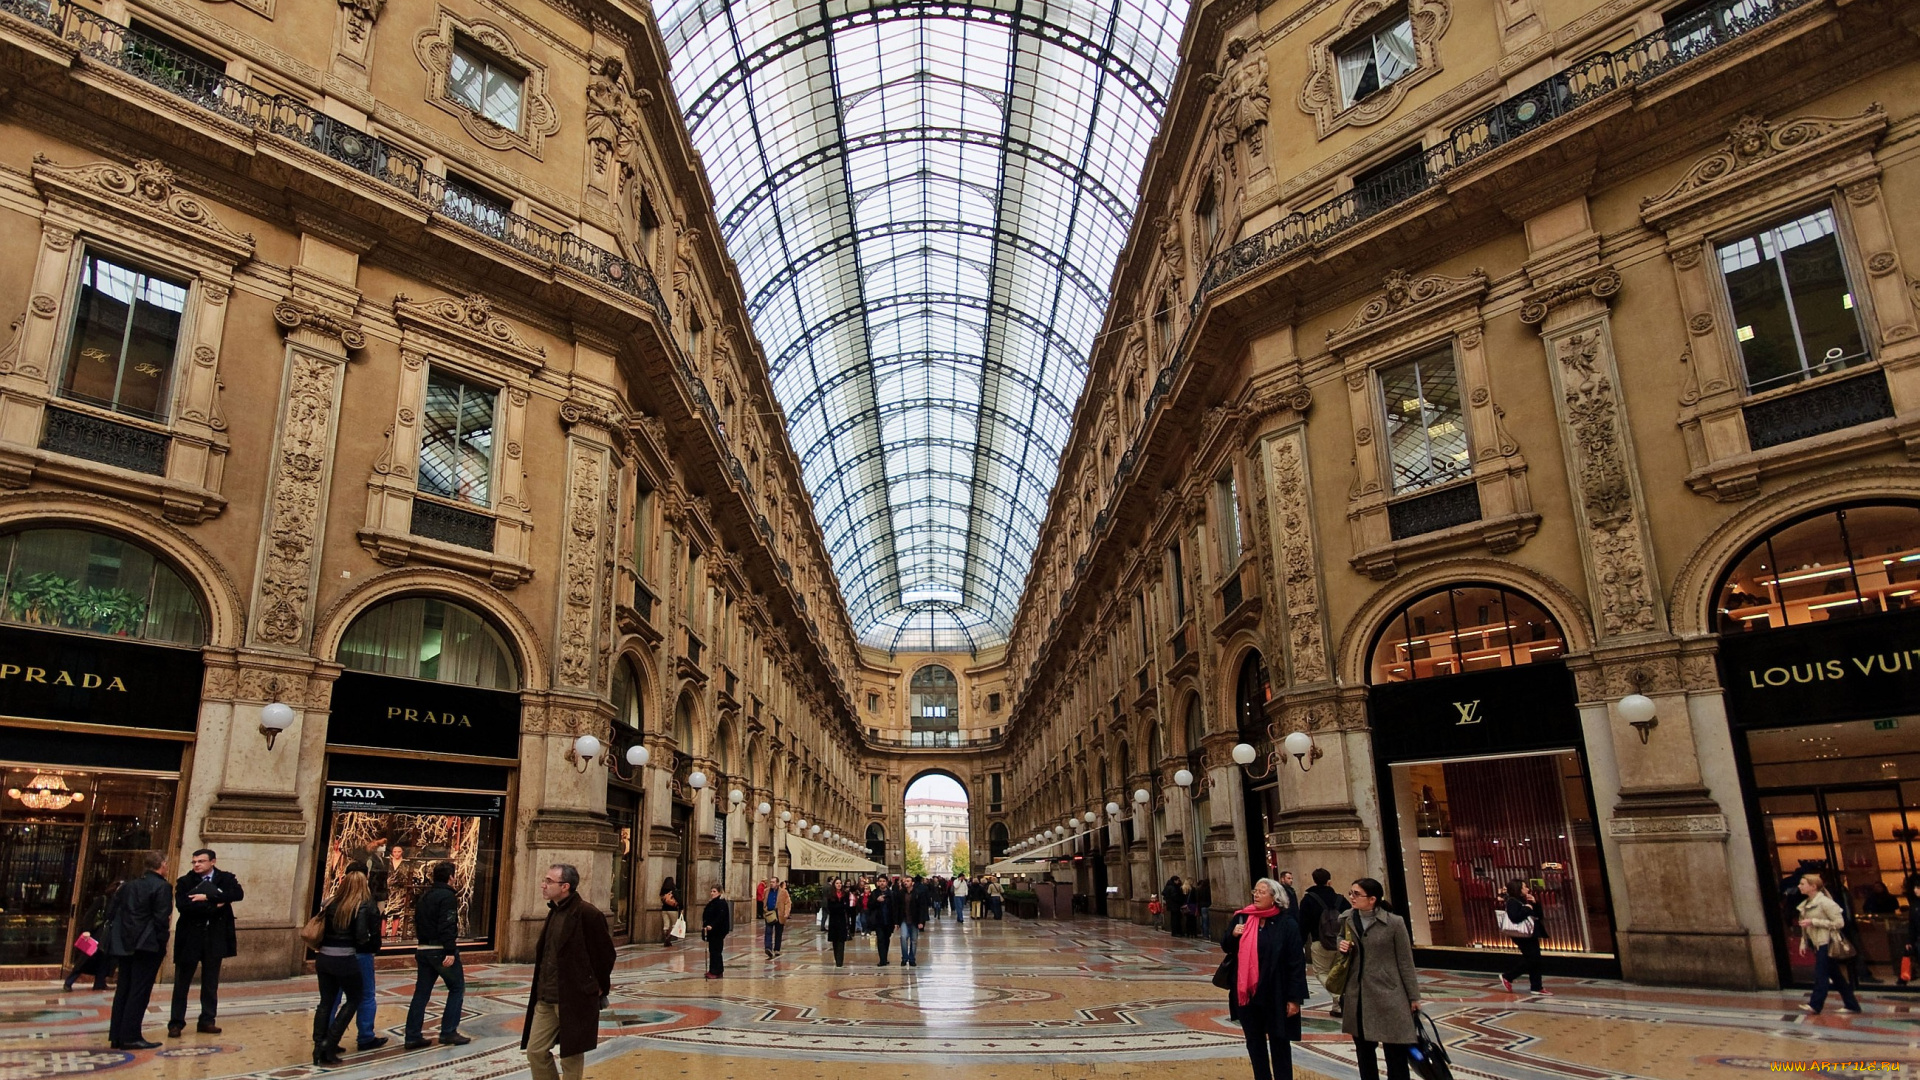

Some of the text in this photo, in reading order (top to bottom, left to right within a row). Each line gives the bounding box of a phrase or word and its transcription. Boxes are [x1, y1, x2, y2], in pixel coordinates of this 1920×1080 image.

[0, 663, 128, 692] PRADA
[1749, 659, 1845, 689] LOUIS
[387, 706, 472, 728] PRADA
[332, 787, 385, 799] PRADA
